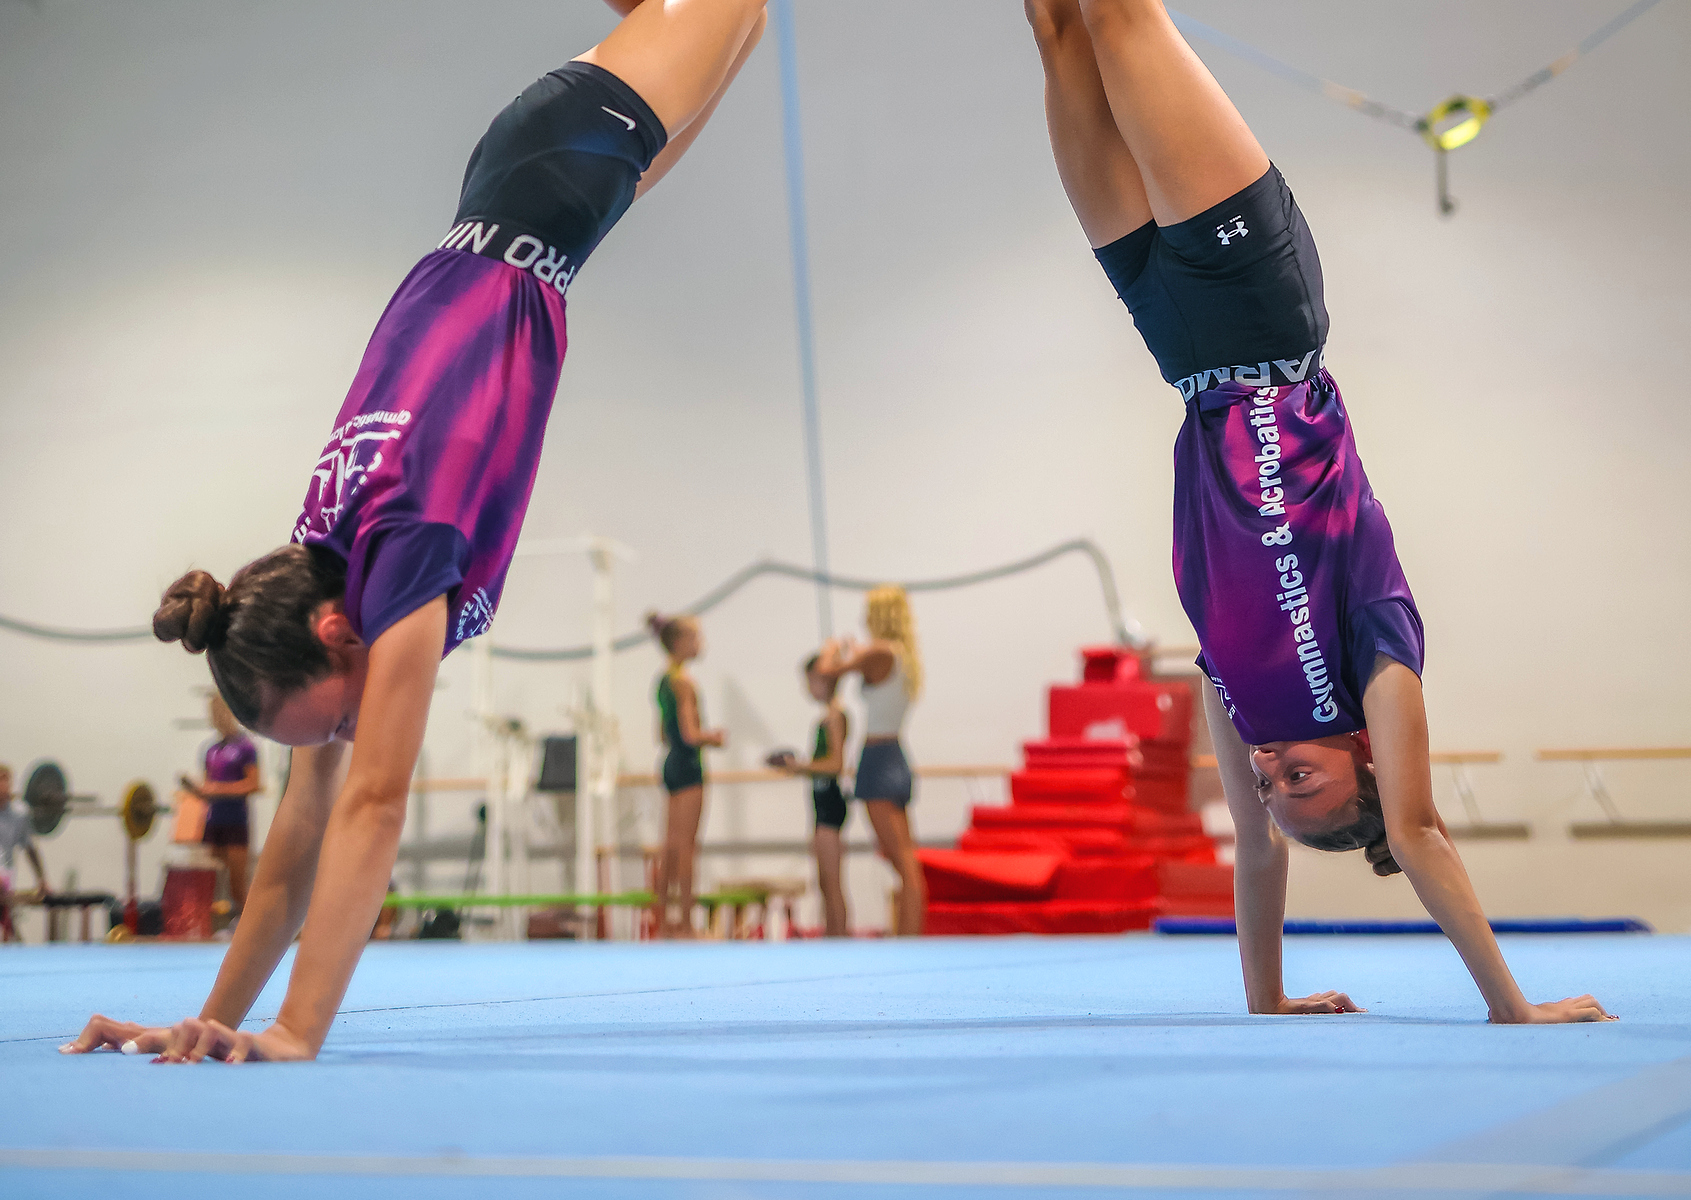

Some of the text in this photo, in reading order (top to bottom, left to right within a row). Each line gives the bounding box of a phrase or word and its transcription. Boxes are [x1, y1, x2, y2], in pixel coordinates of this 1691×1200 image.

[503, 234, 575, 296] PRO
[1249, 385, 1339, 723] Gymnastics & Acrobatics
